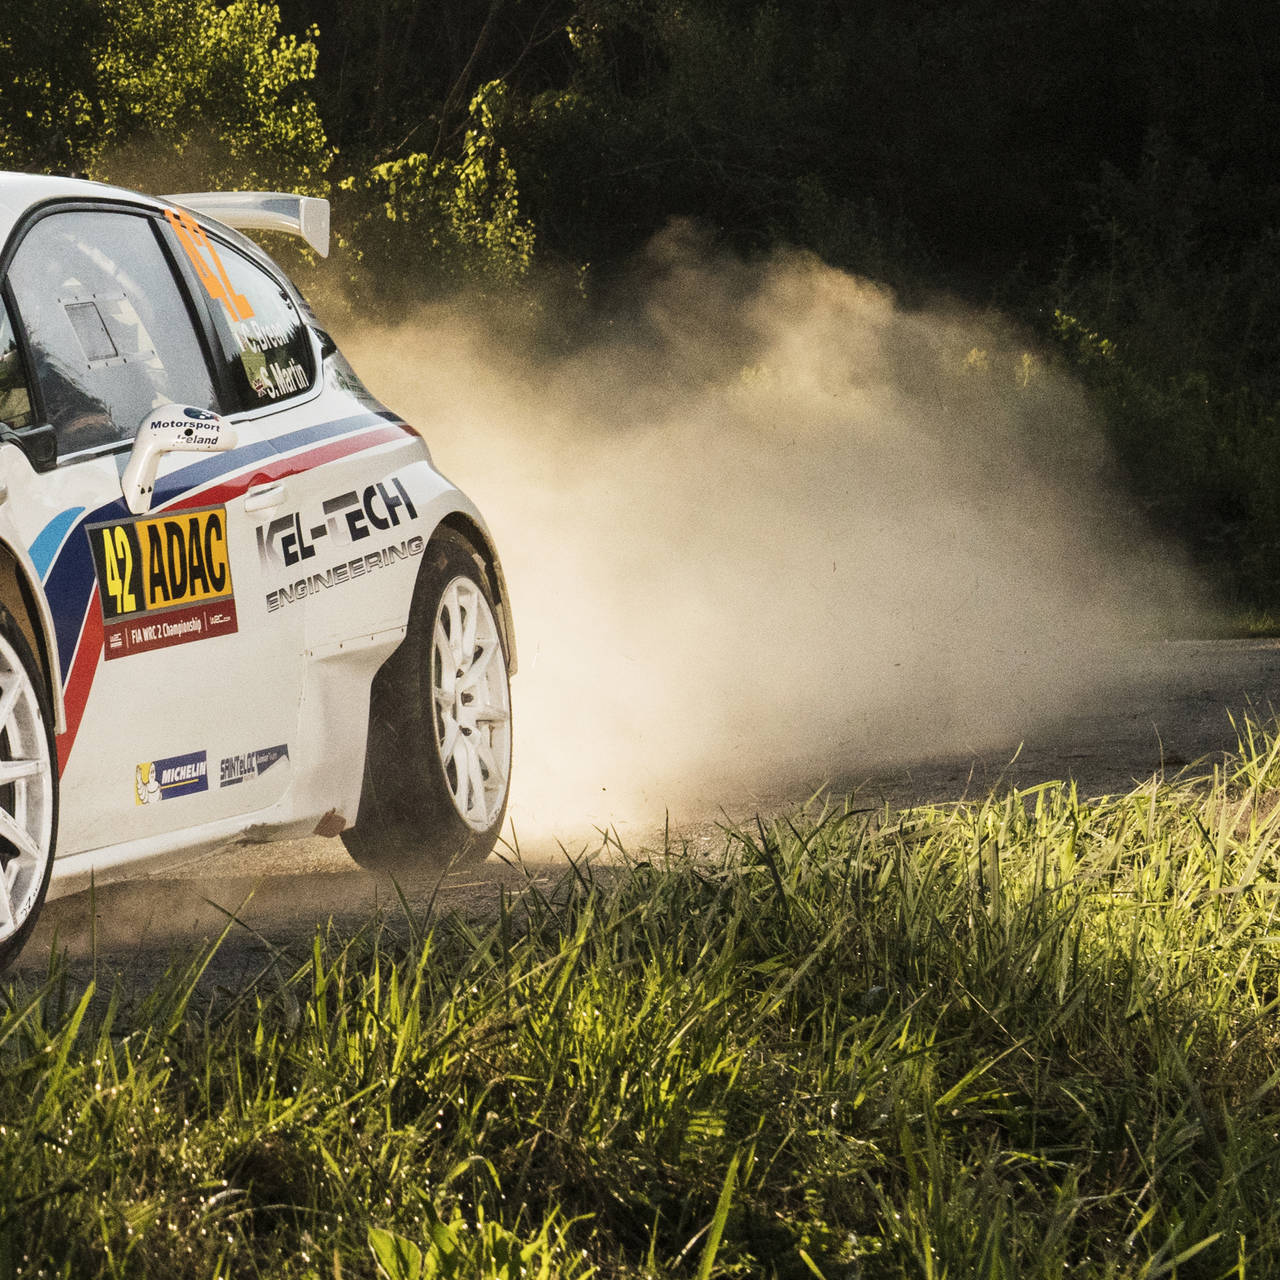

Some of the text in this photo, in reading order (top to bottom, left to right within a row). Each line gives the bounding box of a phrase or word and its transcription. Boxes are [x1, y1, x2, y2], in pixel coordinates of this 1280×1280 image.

[150, 421, 220, 432] Motorsport
[255, 477, 418, 568] KEL-TECH
[102, 513, 226, 614] 42 ADAC
[266, 535, 424, 613] ENGINEERING
[131, 617, 202, 645] FIA WRC 2 Championship
[161, 761, 207, 784] MICHELIN
